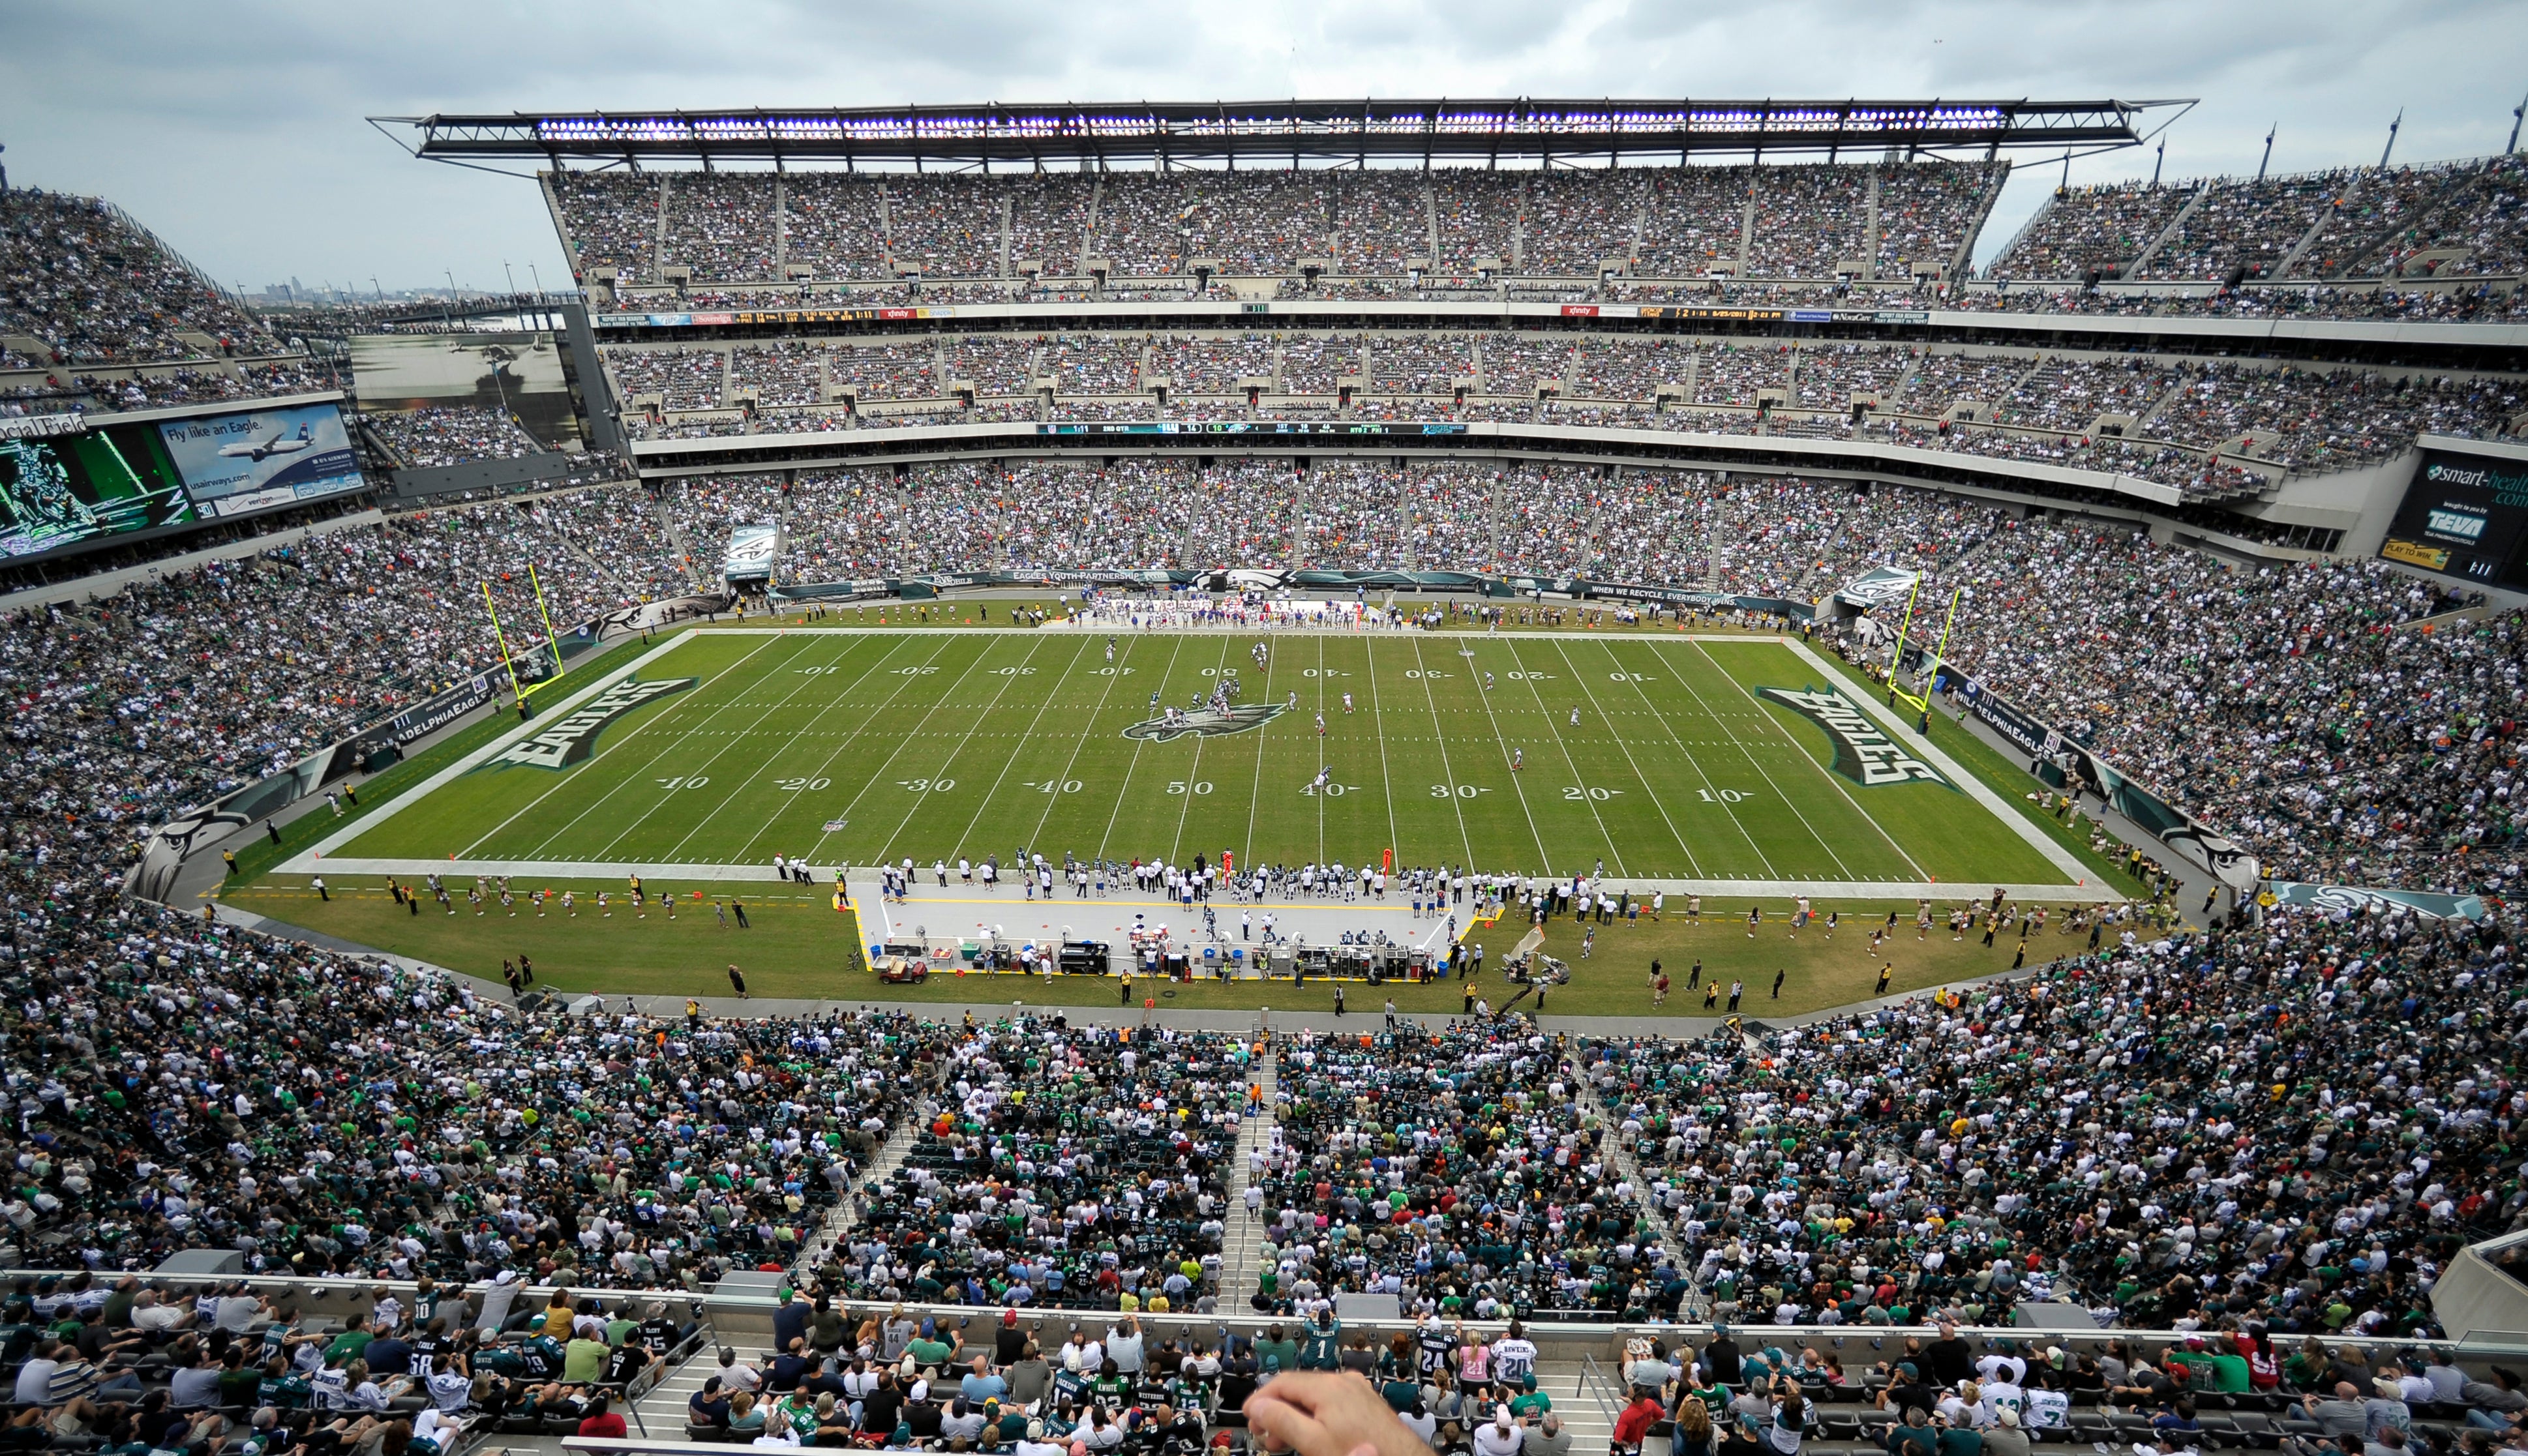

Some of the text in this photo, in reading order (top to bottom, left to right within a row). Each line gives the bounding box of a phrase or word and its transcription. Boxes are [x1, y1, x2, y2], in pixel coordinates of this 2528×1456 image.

[888, 310, 909, 318] xfinity
[1569, 306, 1591, 315] xfinity
[1839, 313, 1871, 321] NovaCare
[699, 315, 731, 323] Sovereign
[37, 414, 88, 437] Field
[167, 419, 262, 443] Fly like an Eagle.
[190, 473, 250, 490] usairways.com
[248, 496, 273, 506] verizon
[2443, 501, 2463, 510] brought
[198, 504, 211, 516] 40
[2428, 511, 2486, 537] TEVA
[2386, 544, 2404, 554] PLAY
[2416, 552, 2431, 561] WIN.
[1013, 572, 1047, 580] EAGLES
[1049, 572, 1076, 580] YOUTH
[1080, 572, 1140, 580] PARTNERSHIP
[1592, 586, 1614, 595] WHEN
[1630, 589, 1664, 599] RECYCLE,
[1666, 593, 1711, 602] EVERYBODY
[1715, 597, 1738, 606] WINS.
[804, 666, 841, 676] 10
[901, 666, 939, 676] 20
[1000, 667, 1037, 676] 30
[1100, 667, 1136, 676] 40
[1201, 668, 1237, 677] 50
[1302, 668, 1338, 677] 40
[1406, 669, 1443, 679] 30
[1507, 671, 1544, 681] 20
[1609, 672, 1644, 682] 10
[485, 678, 692, 768] EAGLES
[1766, 689, 1947, 784] EAGLES
[661, 776, 710, 790] 10
[780, 777, 831, 791] 20
[907, 779, 956, 792] 30
[1036, 779, 1083, 794] 40
[1166, 781, 1214, 795] 50
[1299, 782, 1344, 797] 40
[1431, 784, 1478, 799] 30
[1562, 787, 1610, 801] 20
[1696, 788, 1743, 803] 10
[415, 1303, 429, 1318] 10
[888, 1334, 899, 1343] 44
[1317, 1340, 1326, 1359] 1
[410, 1353, 433, 1375] 58
[1422, 1350, 1444, 1372] 24
[1467, 1360, 1482, 1375] 21
[1505, 1358, 1527, 1378] 20
[612, 1363, 620, 1377] 7
[1057, 1376, 1079, 1393] JACKSON
[799, 1412, 813, 1425] 99
[2045, 1410, 2060, 1425] 7
